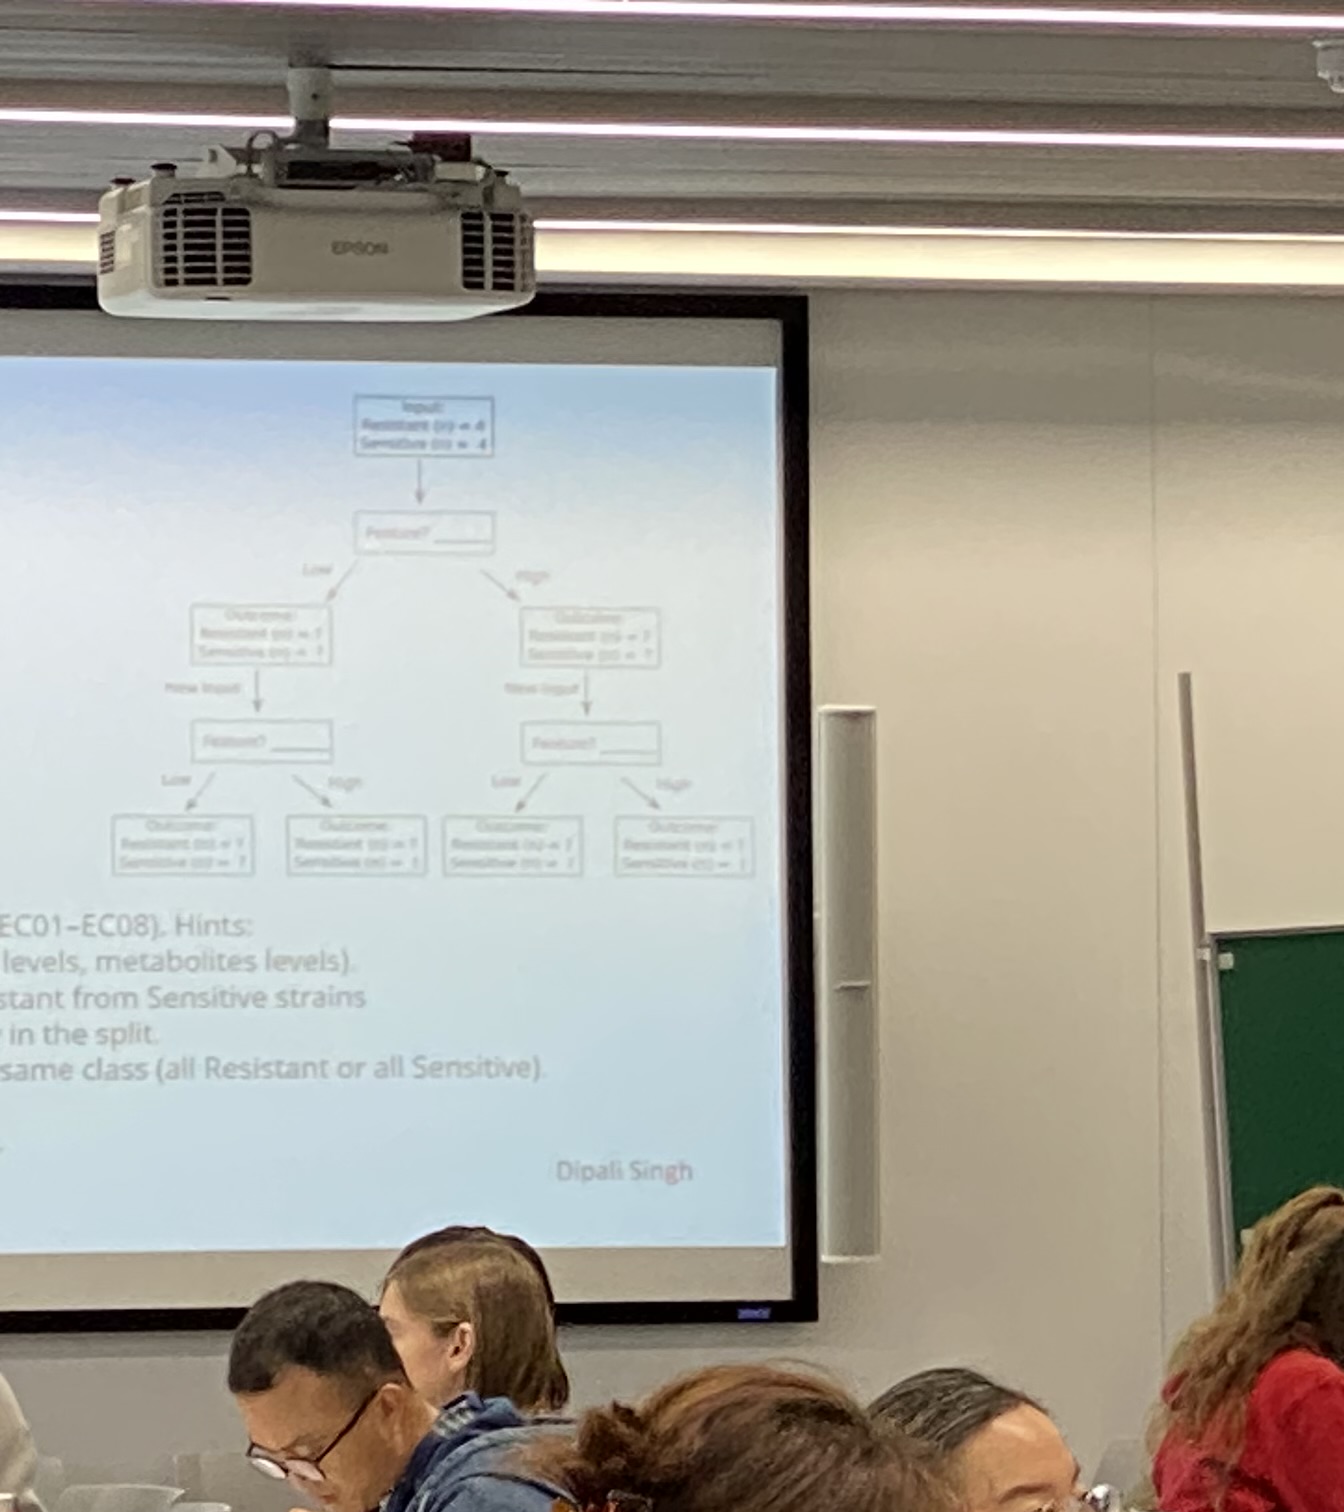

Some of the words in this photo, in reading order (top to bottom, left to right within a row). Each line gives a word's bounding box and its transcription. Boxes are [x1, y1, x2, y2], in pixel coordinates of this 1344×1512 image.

[331, 241, 388, 257] EPSON
[175, 912, 254, 937] Hints:
[3, 949, 87, 975] levels,
[95, 948, 258, 973] metabolites
[73, 986, 139, 1010] from
[148, 986, 268, 1010] Sensitive
[276, 986, 366, 1009] strains
[9, 1022, 34, 1046] in
[43, 1022, 89, 1046] the
[0, 1062, 74, 1082] same
[82, 1056, 150, 1082] class
[156, 1056, 196, 1086] (all
[205, 1056, 329, 1081] Resistant
[336, 1059, 367, 1080] or
[373, 1055, 404, 1080] all
[556, 1160, 624, 1186] Dipali
[629, 1160, 694, 1187] Singh
